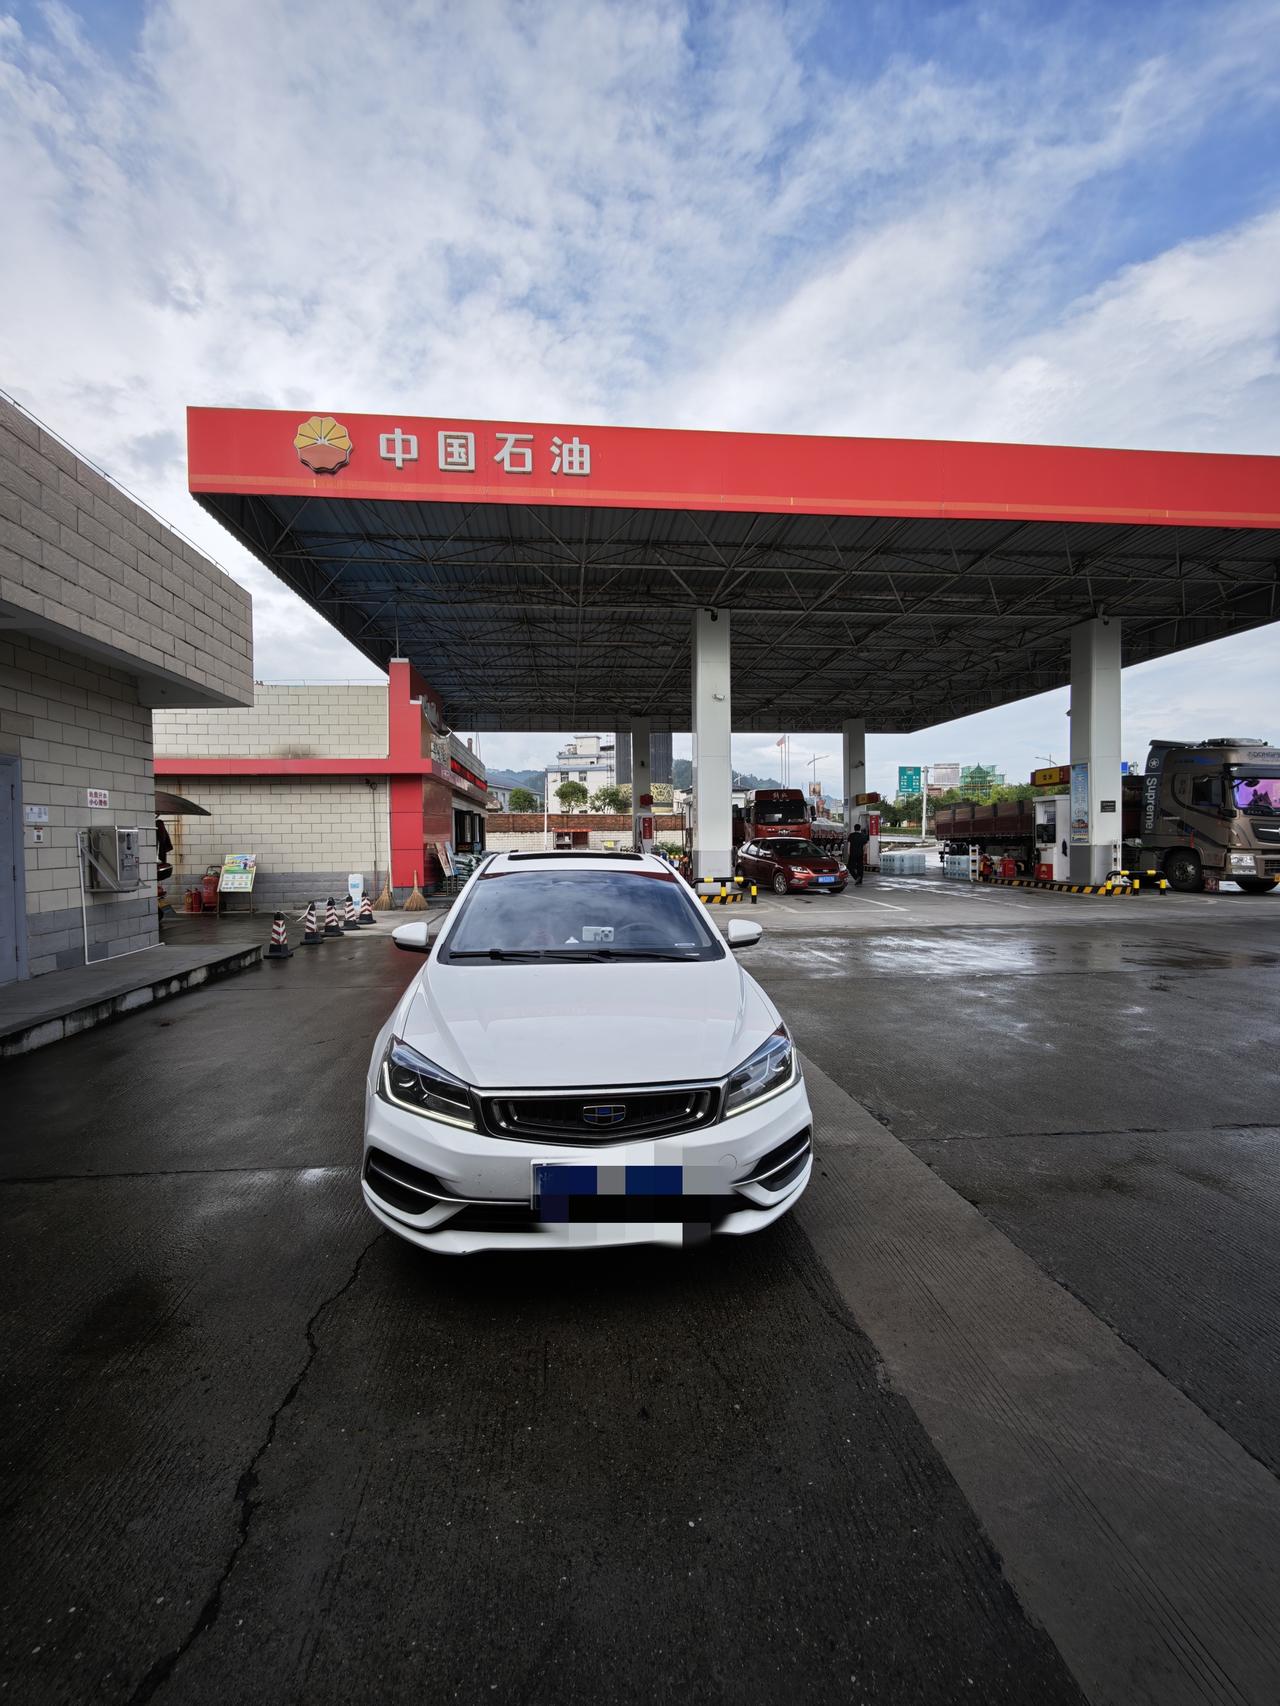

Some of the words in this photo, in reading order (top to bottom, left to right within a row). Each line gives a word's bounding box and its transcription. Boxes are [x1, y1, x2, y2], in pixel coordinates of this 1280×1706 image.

[379, 427, 591, 476] 中国石油
[1145, 777, 1157, 829] Supreme
